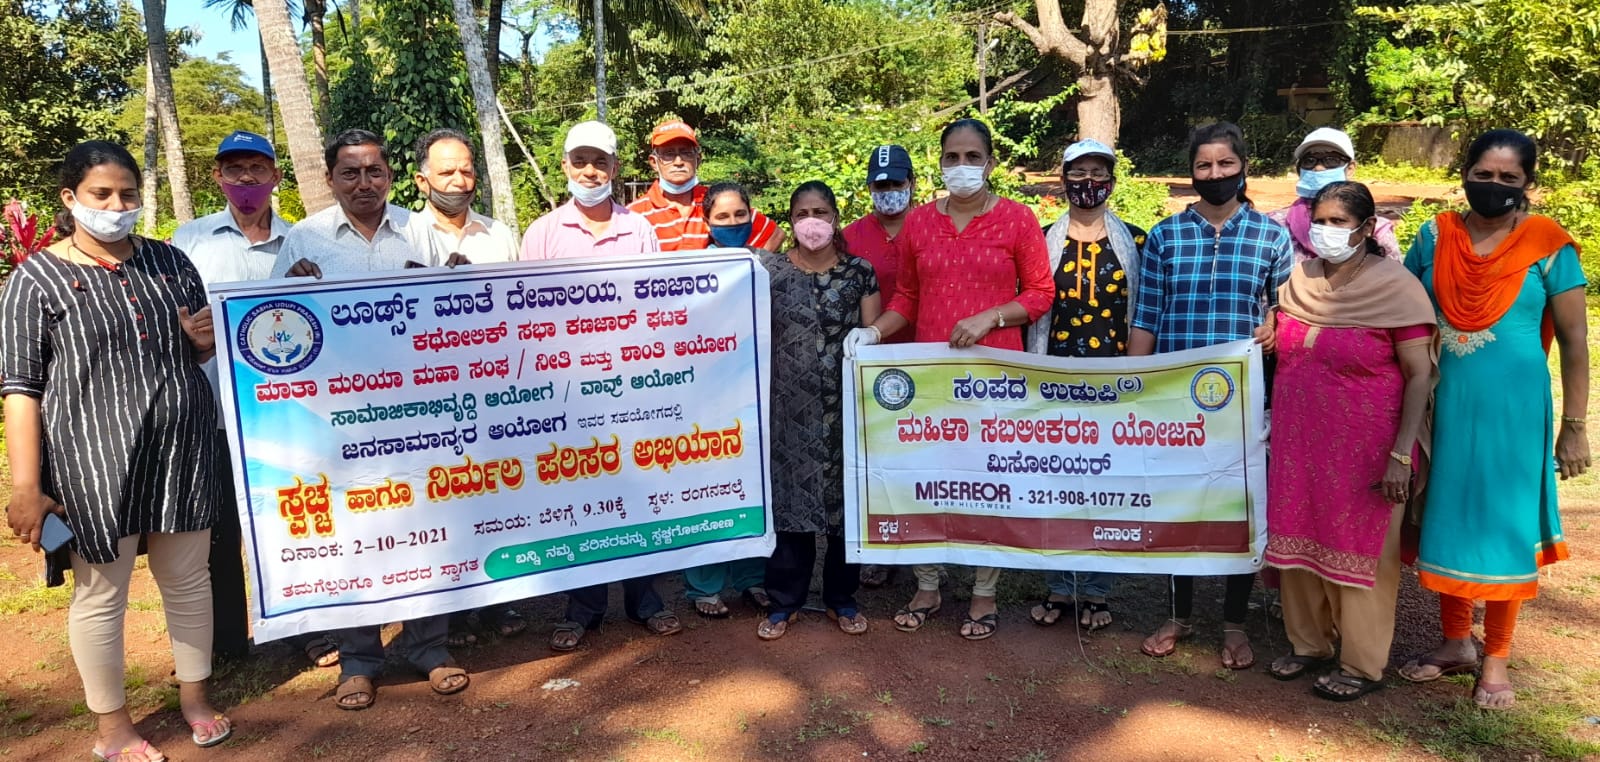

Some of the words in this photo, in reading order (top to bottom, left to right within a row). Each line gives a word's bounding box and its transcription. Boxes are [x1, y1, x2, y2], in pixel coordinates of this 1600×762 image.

[434, 283, 494, 318] ಮಾತೆ
[507, 280, 622, 311] ದೇವಾಲಯ,
[634, 271, 719, 299] ಕಣಜಾರು
[412, 321, 507, 352] ಕಥೋಲಿಕ್
[518, 319, 556, 342] ಸಭಾ
[566, 309, 637, 335] ಕಣಜಾರ್
[646, 306, 688, 331] ಘಟಕ
[256, 379, 317, 402] ಮಾತಾ
[328, 368, 403, 395] ಮರಿಯಾ
[413, 363, 459, 385] ಮಹಾ
[469, 353, 509, 379] ಸಂಘ
[516, 348, 525, 379] /
[535, 350, 571, 372] ನೀತಿ
[580, 350, 613, 371] ಮತ್ತು
[620, 341, 665, 362] ಶಾಂತಿ
[674, 332, 738, 357] ಆಯೋಗ
[484, 381, 554, 408] ಆಯೋಗ
[564, 380, 570, 403] /
[630, 365, 695, 389] ಆಯೋಗ
[953, 371, 1027, 401] ಸಂಪದ
[341, 423, 478, 460] ಜನಸಾಮಾನ್ಯರ
[488, 411, 568, 441] ಆಯೋಗ
[577, 412, 605, 429] ಇವರ
[610, 403, 683, 424] ಸಹಯೋಗದಲ್ಲಿ
[898, 412, 969, 443] ಮಹಿಳಾ
[980, 411, 1100, 445] ಸಬಲೀಕರಣ
[1112, 412, 1206, 447] ಯೋಜನೆ
[346, 478, 412, 510] ಹಾಗೂ
[427, 456, 524, 501] ನಿರ್ಮಲ
[536, 434, 621, 484] ಪರಿಸರ
[633, 418, 743, 472] ಅಭಿಯಾನ
[986, 450, 1111, 475] ಮಿಸೋರಿಯರ್
[915, 480, 1011, 503] MISEREOR
[1028, 490, 1125, 507] 321-908-1077
[1130, 493, 1152, 507] ZG
[959, 502, 1011, 510] HILFSWERK
[280, 541, 343, 562] ದಿನಾಂಕ:
[473, 514, 531, 535] ಸಮಯ:
[539, 504, 577, 527] ಬೆಳಿಗ್ಗೆ
[583, 496, 627, 519] 9.30ಕ್ಕೆ
[648, 491, 674, 515] ಸ್ಥಳ:
[681, 478, 746, 500] ರಂಗನಪಲ್ಕೆ
[878, 519, 899, 543] ಸ್ಥಳ
[1093, 525, 1142, 541] ದಿನಾಂಕ
[515, 550, 542, 566] ಬನ್ನಿ
[545, 543, 575, 561] ನಮ್ಮ
[579, 531, 648, 553] ಪರಿಸರವನ್ನು
[282, 575, 374, 597] ತಮಗೆಲ್ಲರಿಗೂ
[382, 565, 432, 586] ಆದರದ
[440, 558, 480, 582] ಸ್ವಾಗತ
